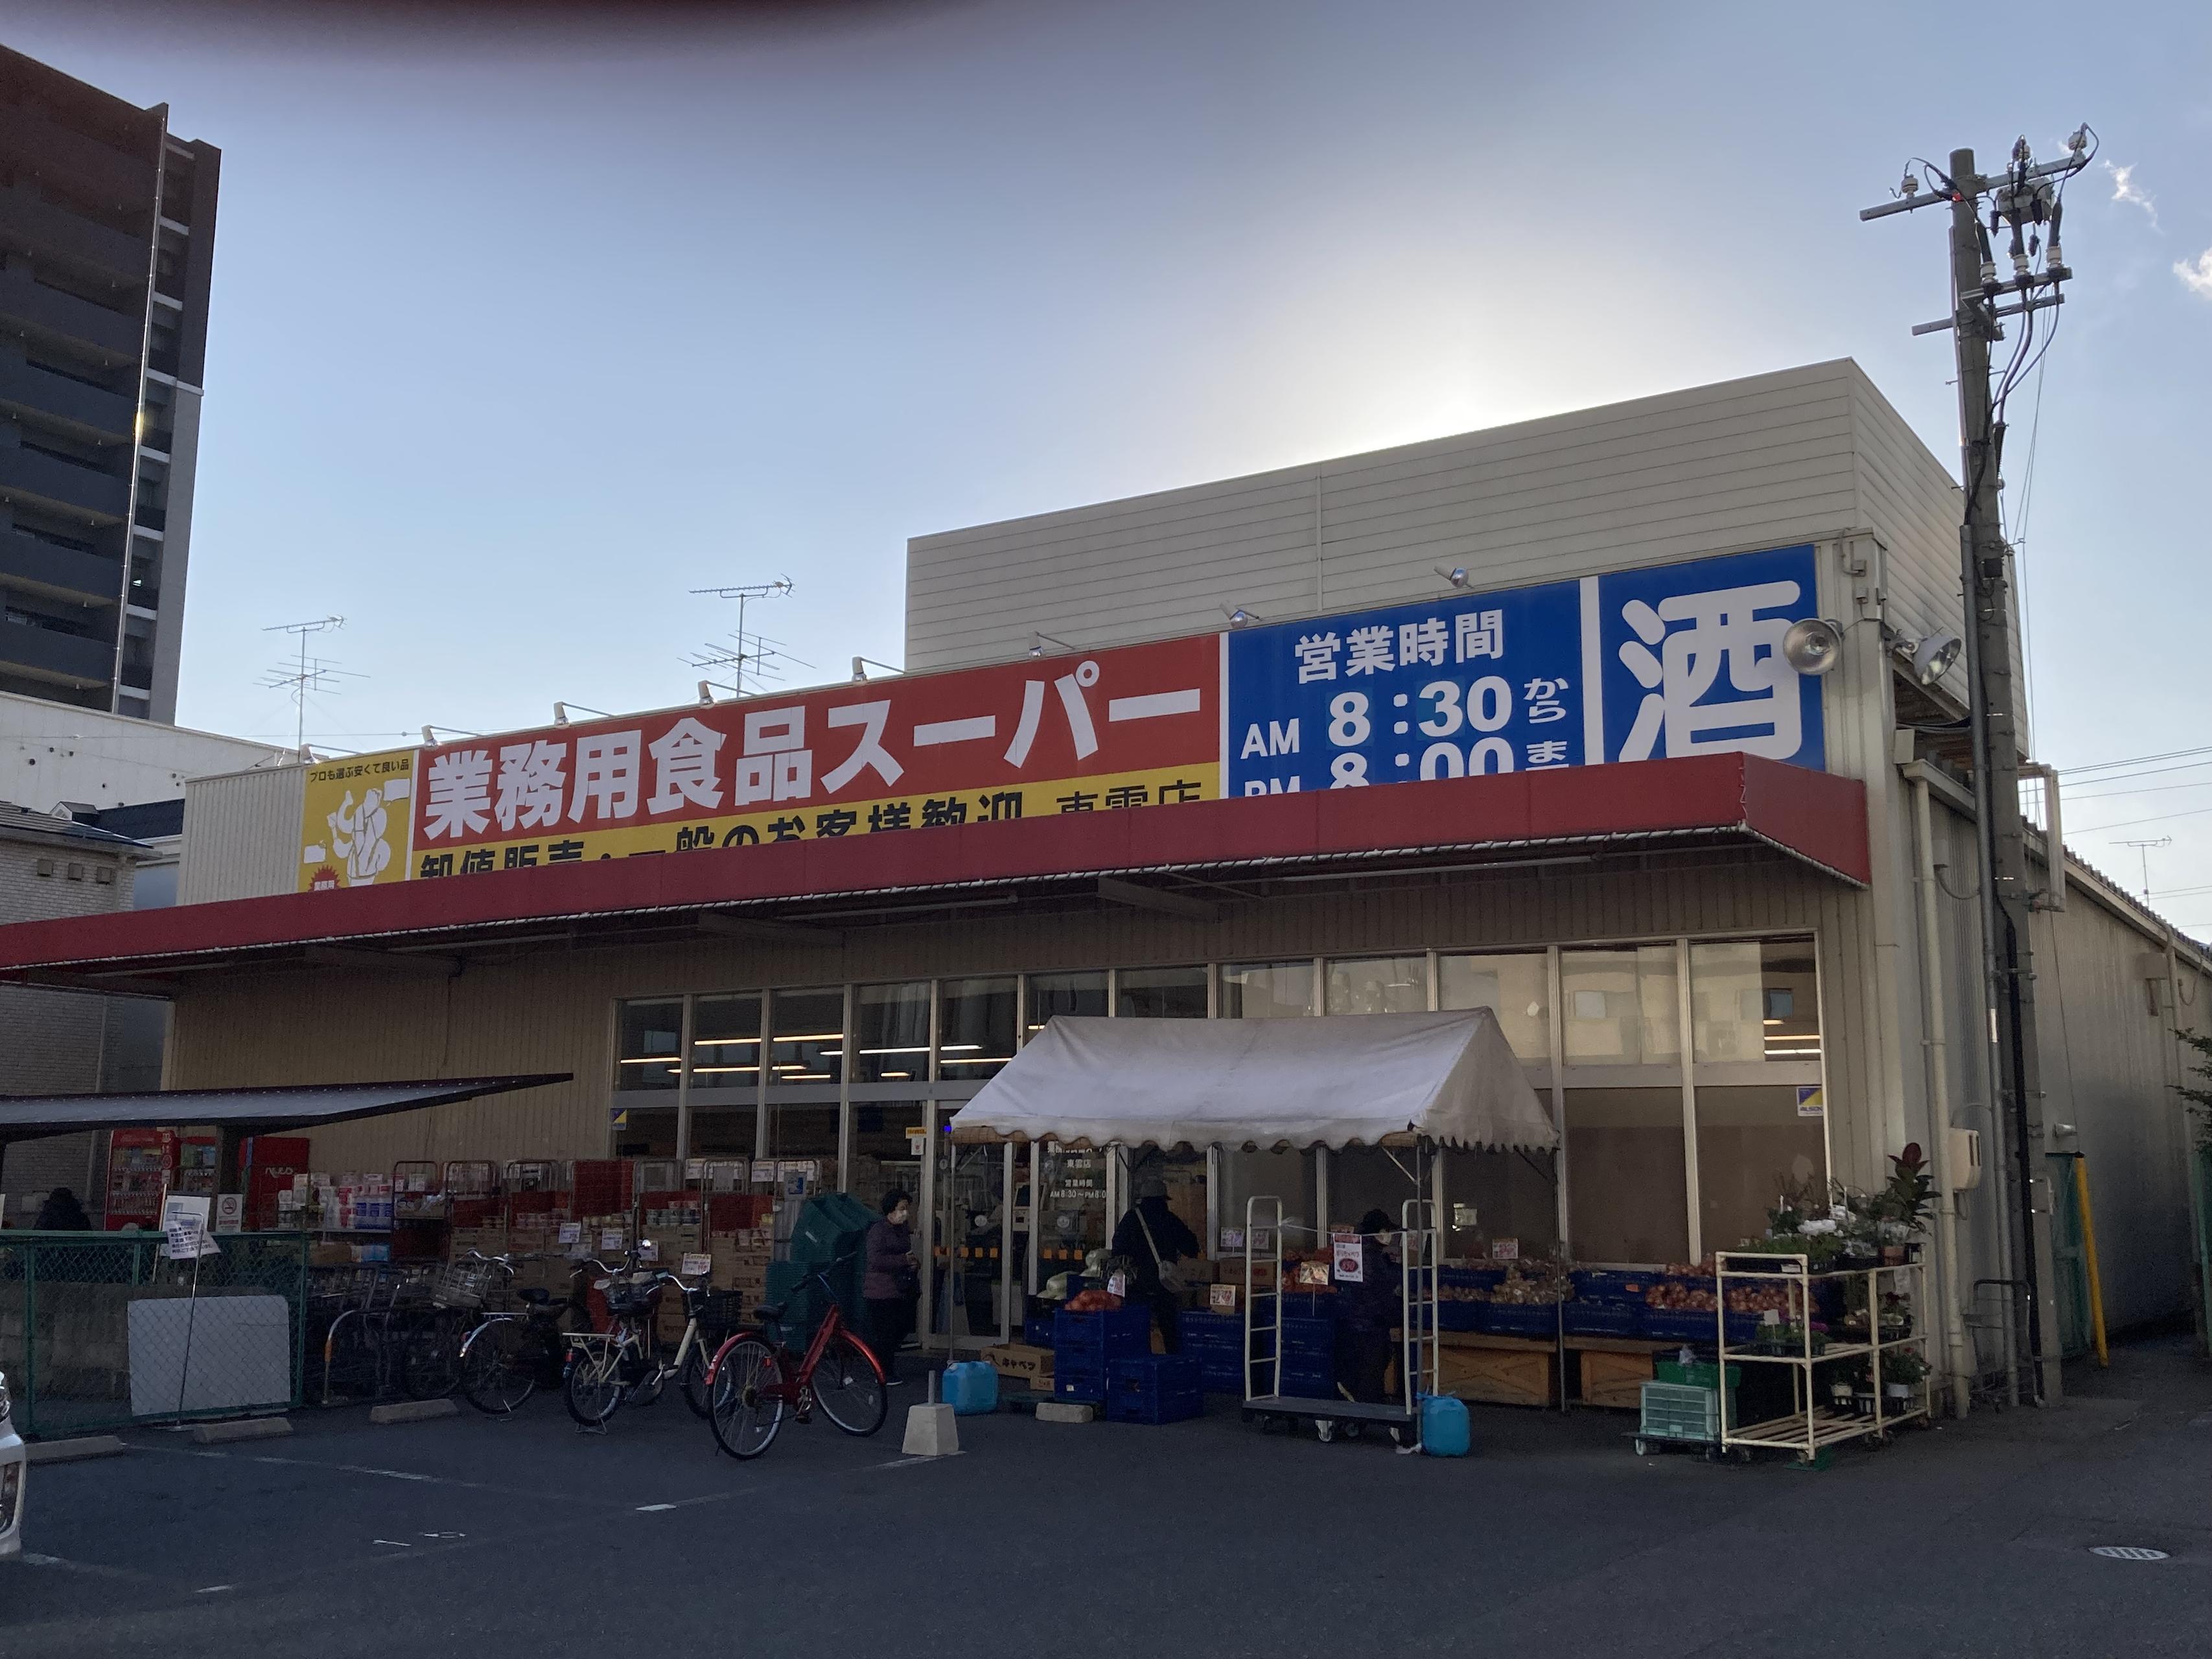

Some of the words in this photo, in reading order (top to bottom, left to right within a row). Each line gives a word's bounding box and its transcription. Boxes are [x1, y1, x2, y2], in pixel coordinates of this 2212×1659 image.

[1294, 609, 1504, 684] 営業時間
[1618, 580, 1802, 763] 酒
[423, 660, 1200, 841] 業務用食品スーパー
[1240, 717, 1300, 760] AM
[1327, 676, 1514, 748] 8:30
[1523, 677, 1569, 724] から
[1525, 740, 1570, 772] ま
[310, 758, 409, 783] プロも選ぶ安くて良い品
